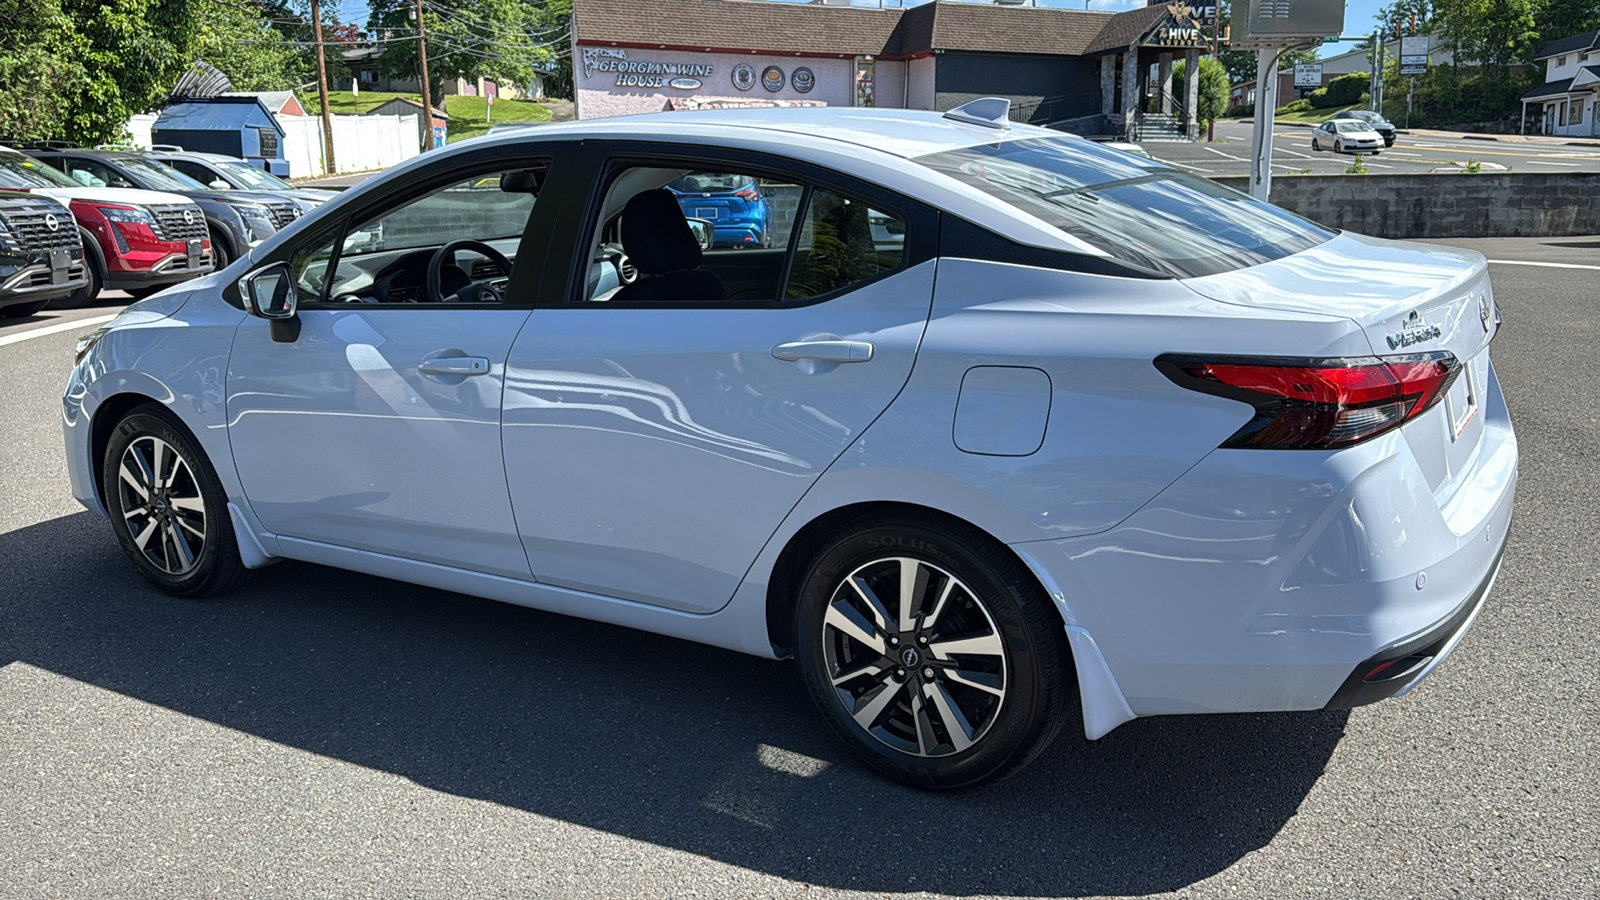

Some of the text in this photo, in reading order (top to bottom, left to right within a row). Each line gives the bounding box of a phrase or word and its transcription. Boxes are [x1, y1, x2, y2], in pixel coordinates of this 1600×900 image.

[1169, 28, 1198, 40] HIVE
[599, 60, 714, 77] GEORGIAN WINE
[616, 74, 663, 88] HOUSE
[867, 534, 940, 555] SOLUS
